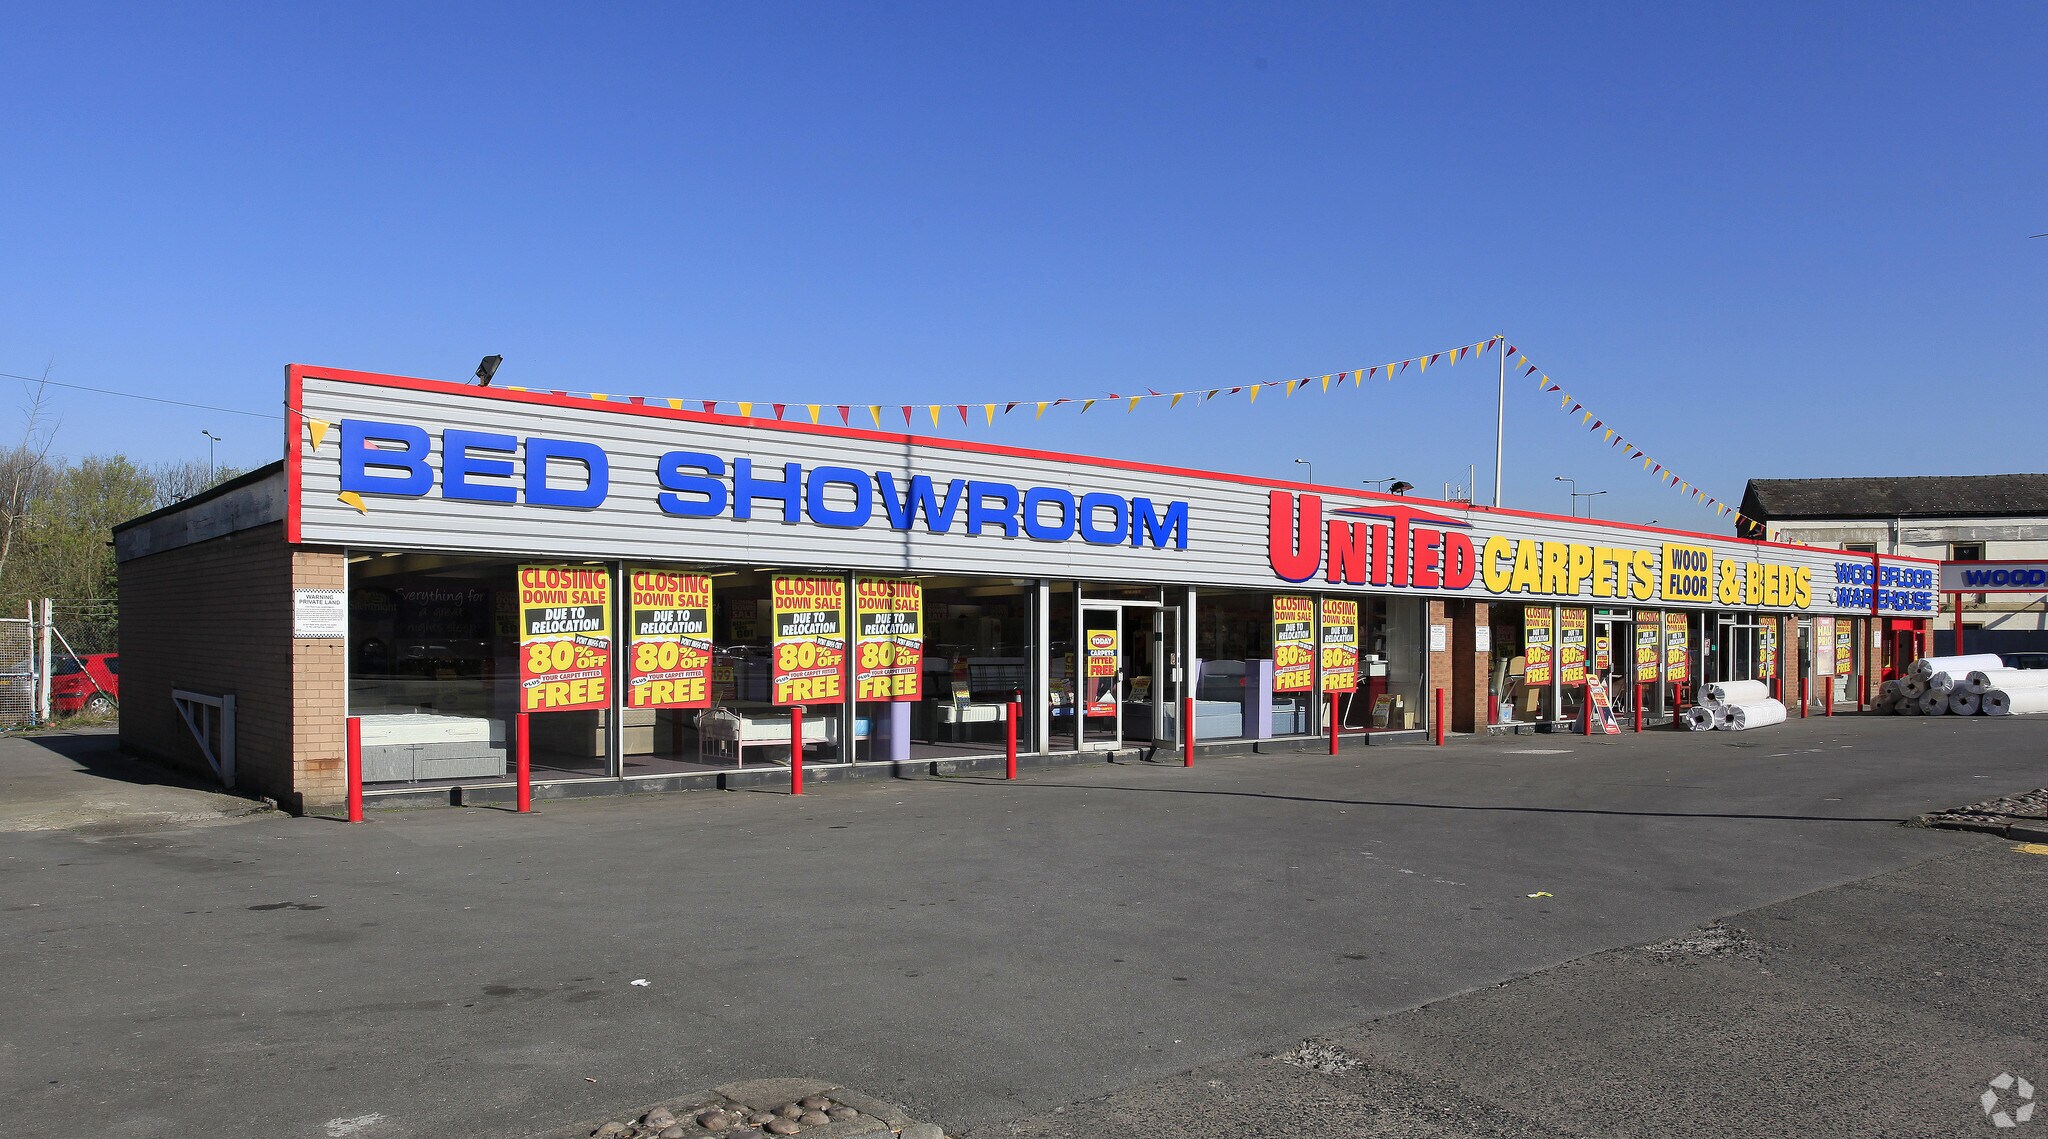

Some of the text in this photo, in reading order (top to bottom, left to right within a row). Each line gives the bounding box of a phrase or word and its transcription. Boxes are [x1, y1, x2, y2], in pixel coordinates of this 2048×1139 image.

[340, 419, 1189, 551] BED SHOWROOM
[1269, 490, 1654, 600] UNITED CARPETS
[1671, 548, 1708, 571] WOOD
[522, 568, 606, 589] CLOSING
[633, 571, 709, 593] CLOSING
[1719, 559, 1811, 609] & BEDS
[1965, 569, 2046, 585] WOOD
[775, 577, 841, 597] CLOSING
[858, 578, 919, 598] CLOSING
[1669, 574, 1708, 597] FLOOR
[523, 590, 568, 604] DOWN
[572, 590, 605, 604] SALE
[633, 593, 709, 608] DOWN SALE
[775, 597, 841, 609] DOWN SALE
[1275, 597, 1312, 611] CLOSING
[1835, 587, 1932, 611] WAREHOUSE
[859, 598, 919, 611] DOWN SALE
[1322, 600, 1355, 615] CLOSING
[545, 607, 585, 621] DUE TO
[653, 610, 690, 623] DUE TO
[793, 612, 825, 624] DUE TO
[876, 612, 905, 624] DUE TO
[1275, 611, 1311, 621] DOWN SALE
[1322, 615, 1355, 625] DOWN SALE
[1526, 608, 1550, 619] CLOSING
[1562, 610, 1584, 620] CLOSING
[531, 618, 599, 634] RELOCATION
[640, 621, 702, 634] RELOCATION
[782, 622, 836, 636] RELOCATION
[865, 623, 915, 635] RELOCATION
[1092, 637, 1112, 645] TODAY
[1279, 630, 1309, 640] RELOCATION
[1324, 634, 1353, 642] RELOCATION
[576, 655, 607, 669] OFF
[680, 655, 709, 669] OFF
[817, 655, 842, 667] OFF
[897, 654, 920, 666] OFF
[1298, 655, 1312, 664] OFF
[1342, 658, 1356, 666] OFF
[559, 672, 581, 680] CARPET
[665, 671, 684, 679] CARPET
[1091, 665, 1115, 676] FREE
[1526, 667, 1549, 683] FREE
[1563, 667, 1583, 682] FREE
[1639, 666, 1656, 681] FREE
[1668, 666, 1686, 680] FREE
[859, 674, 918, 699] FREE
[1277, 670, 1311, 690] FREE
[1323, 672, 1354, 690] FREE
[527, 677, 605, 710] FREE
[634, 677, 706, 706] FREE
[778, 674, 840, 702] FREE
